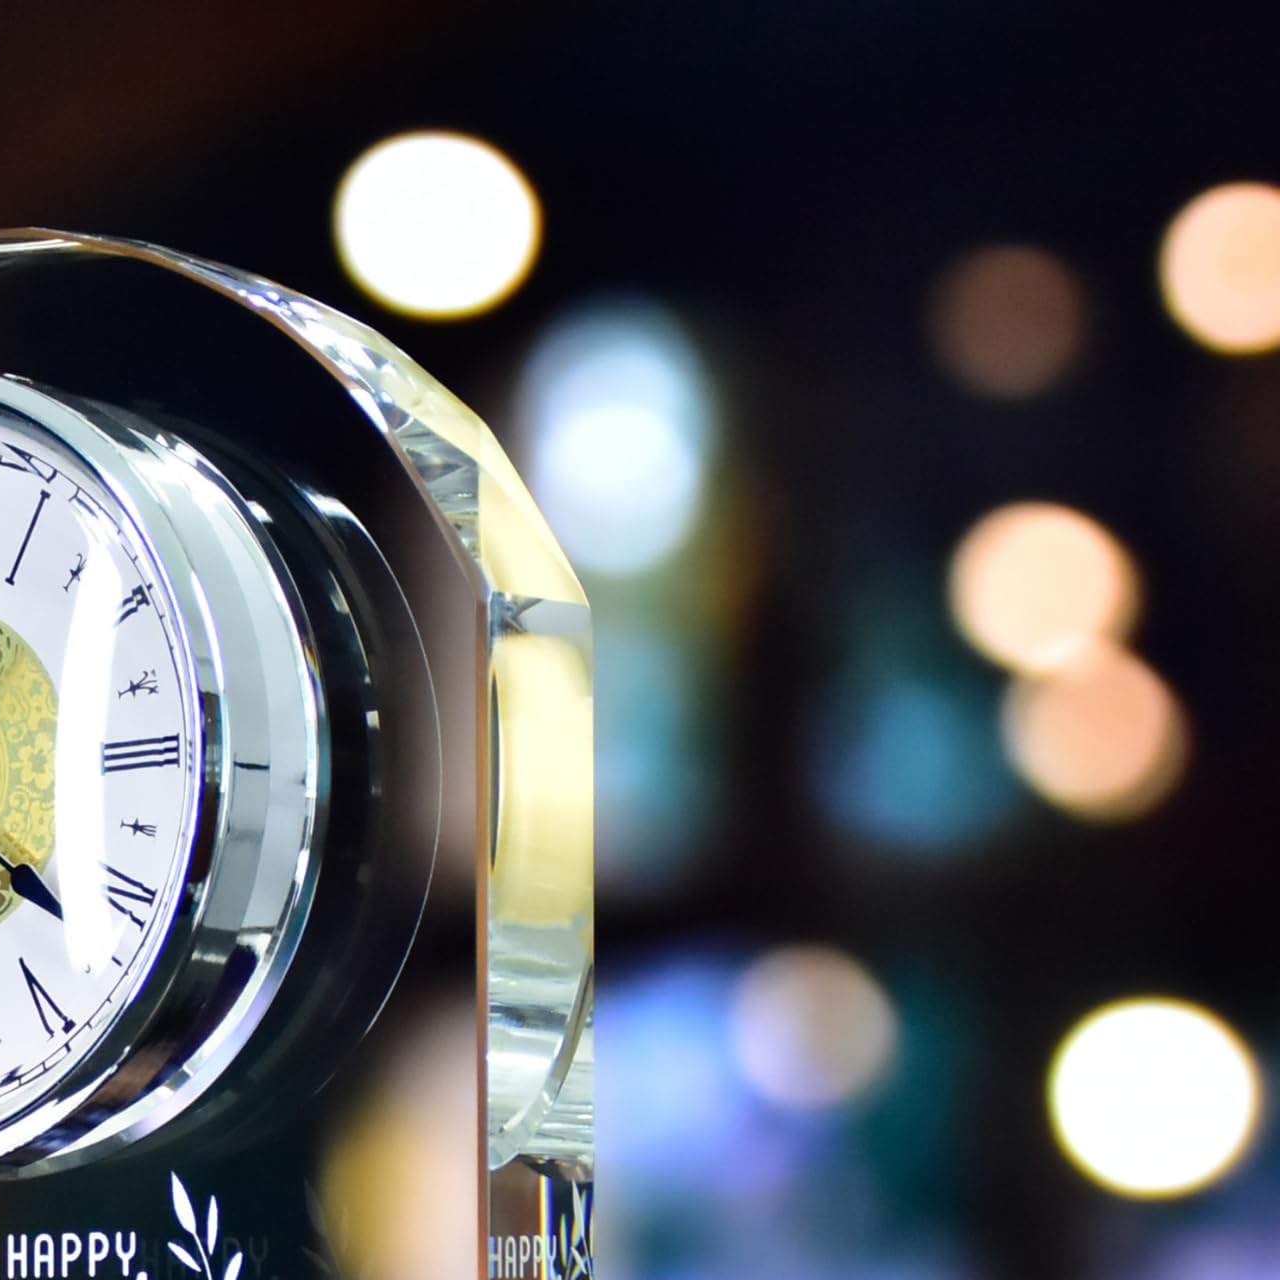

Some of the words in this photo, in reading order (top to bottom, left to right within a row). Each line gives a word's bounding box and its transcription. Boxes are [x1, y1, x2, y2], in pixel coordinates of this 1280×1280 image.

[5, 490, 51, 585] I
[103, 733, 180, 773] III
[19, 957, 76, 1040] V
[6, 1231, 138, 1280] HAPPY
